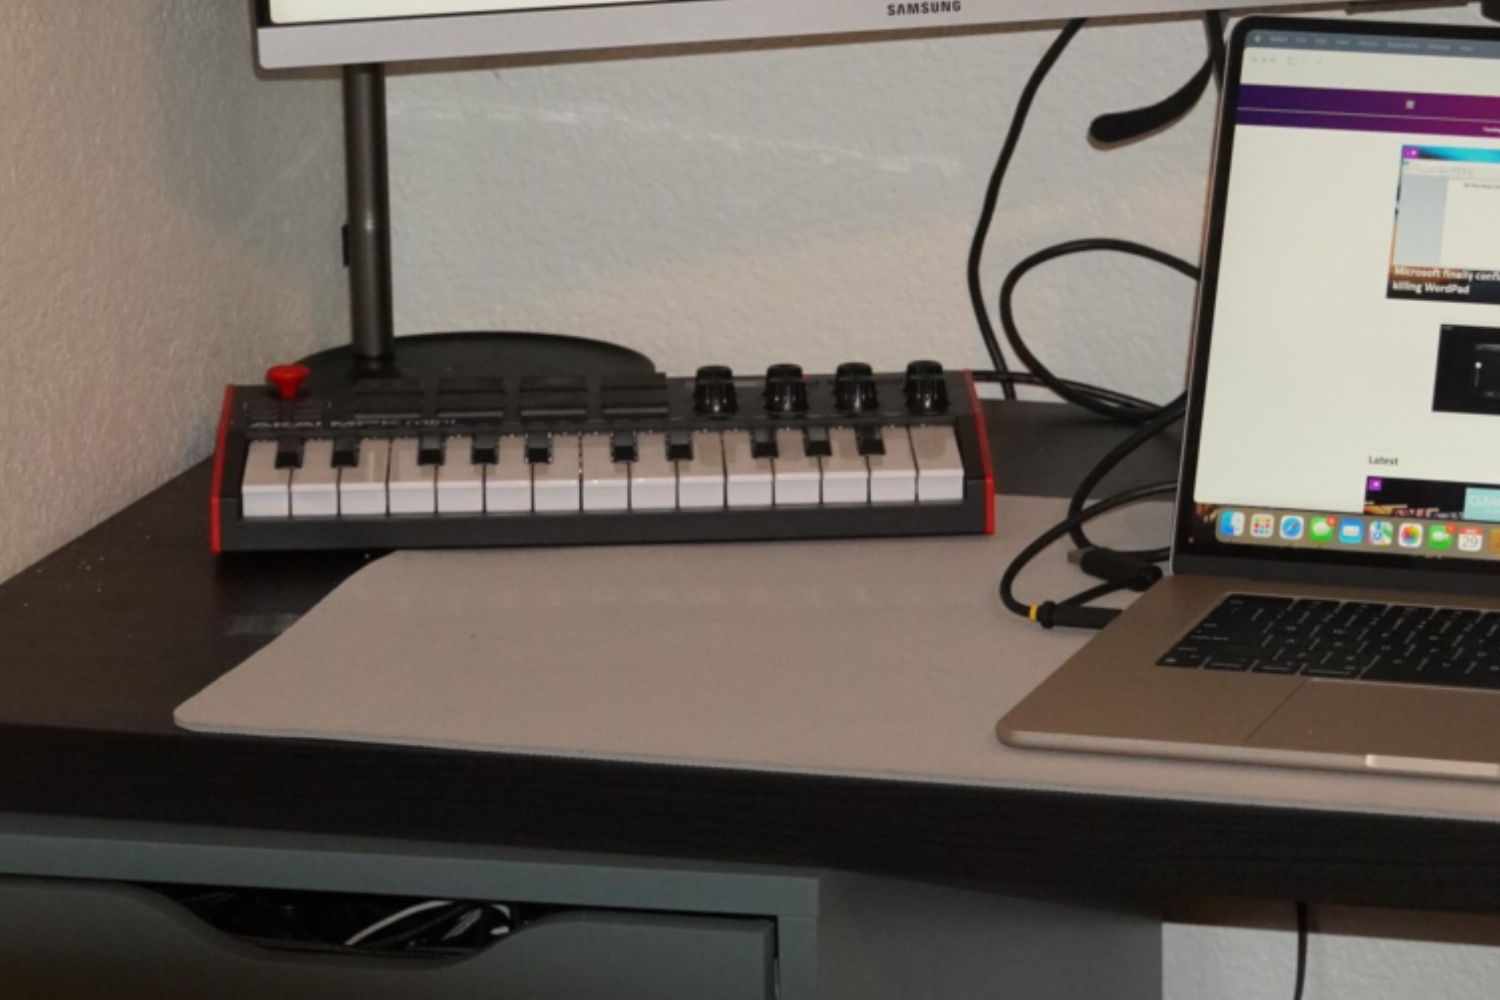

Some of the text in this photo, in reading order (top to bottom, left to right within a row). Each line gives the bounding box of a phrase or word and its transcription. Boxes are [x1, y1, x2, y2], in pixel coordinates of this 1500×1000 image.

[887, 0, 961, 16] SAMSUNG
[1395, 266, 1440, 279] Microsoft
[1442, 266, 1473, 281] finally
[1393, 281, 1470, 295] killing WordPad
[1368, 455, 1399, 467] Latest
[1461, 535, 1479, 548] 29
